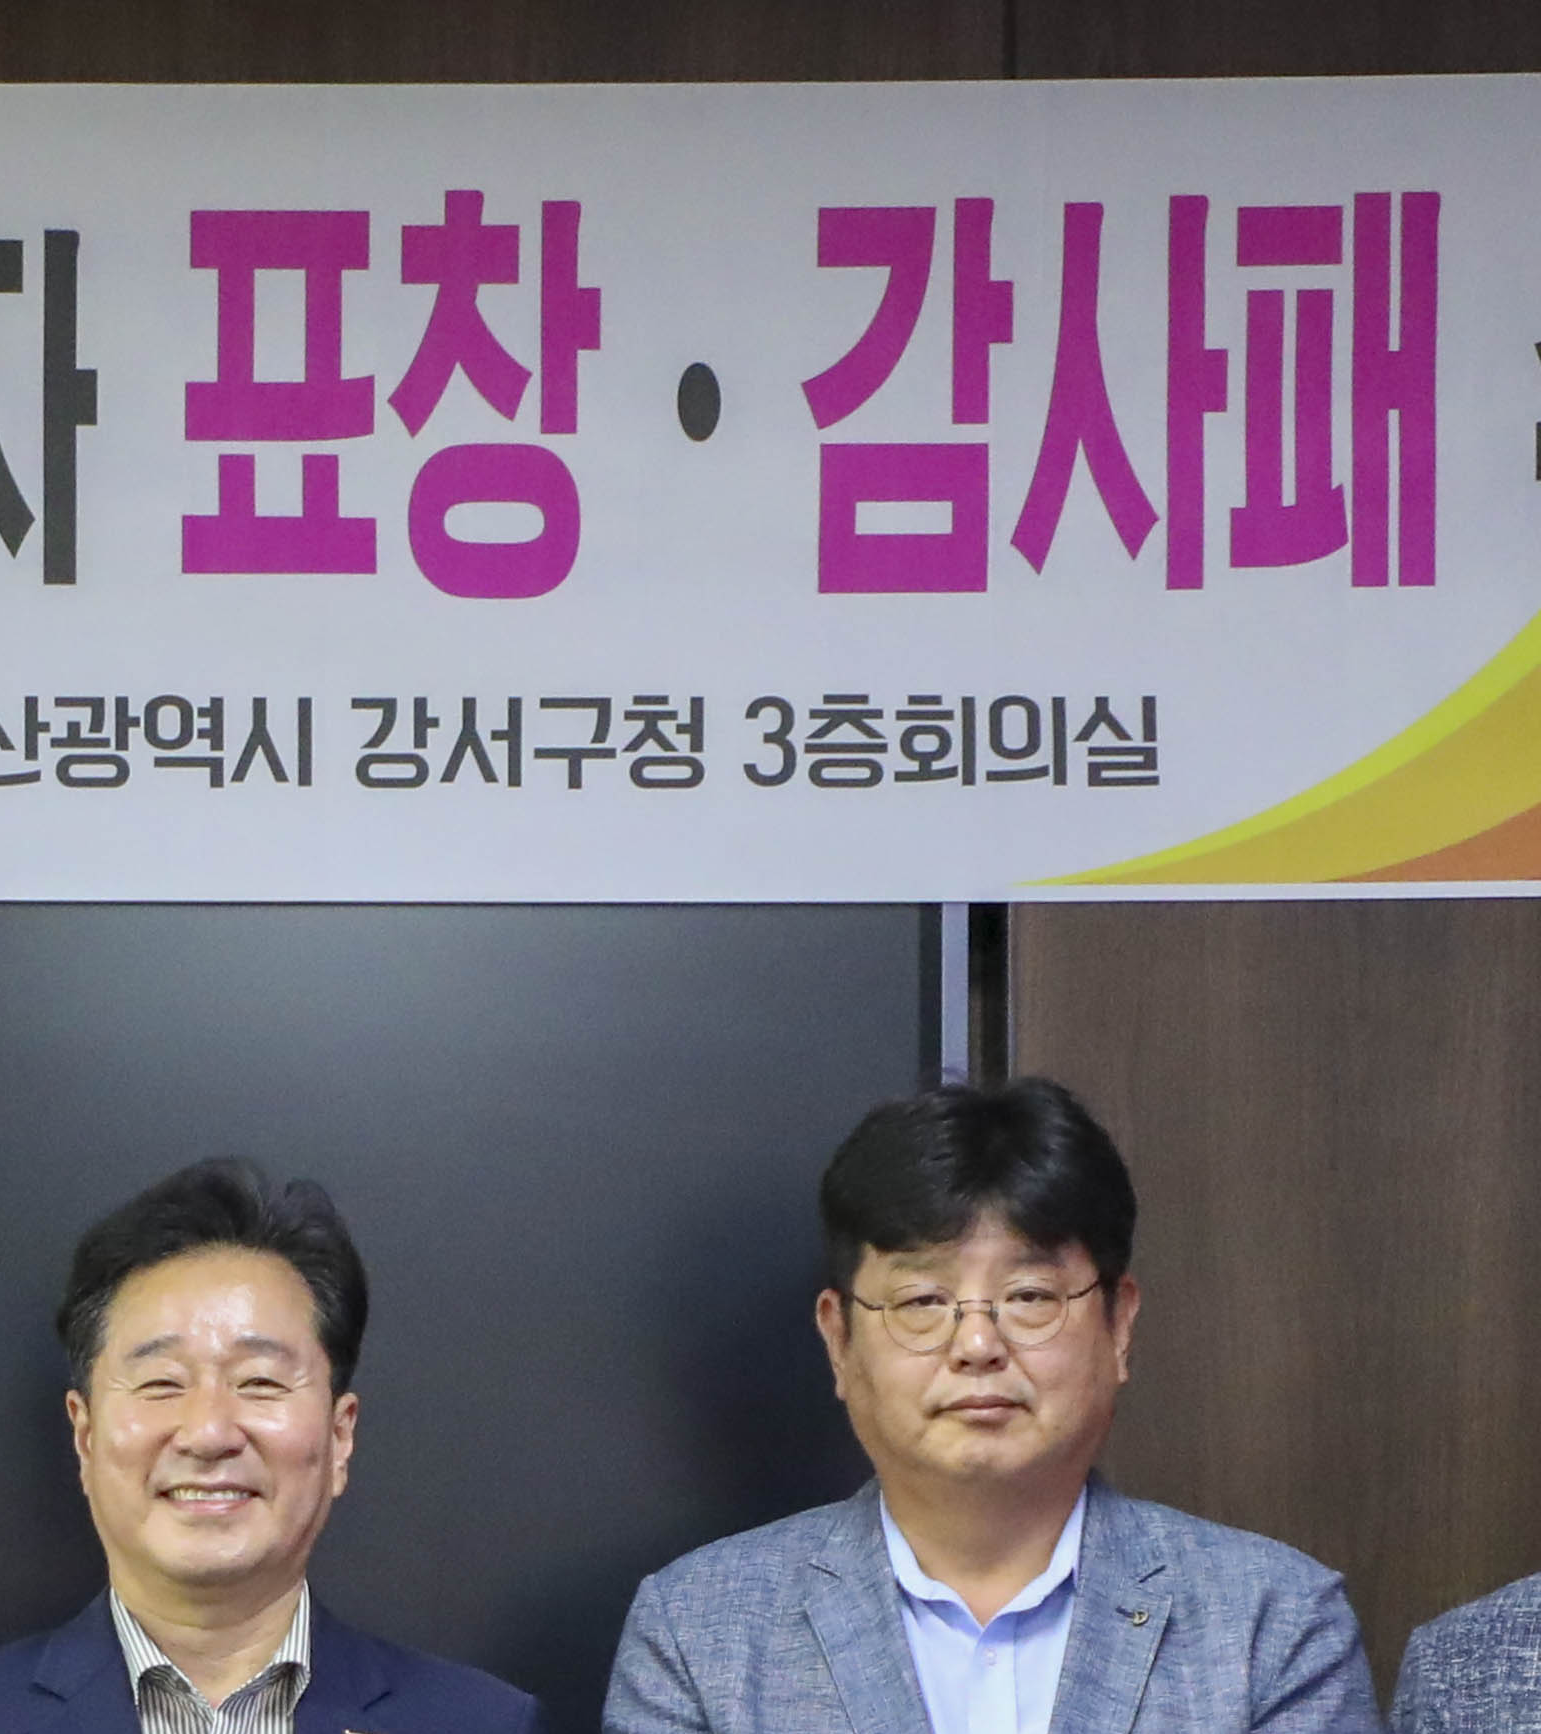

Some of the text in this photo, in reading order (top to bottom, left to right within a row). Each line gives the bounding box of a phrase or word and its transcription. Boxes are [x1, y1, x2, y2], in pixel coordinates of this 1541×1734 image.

[182, 190, 602, 599] 표창
[801, 191, 1442, 594] 감사패
[352, 696, 705, 788] 강서구청
[744, 695, 1159, 787] 3층회의실
